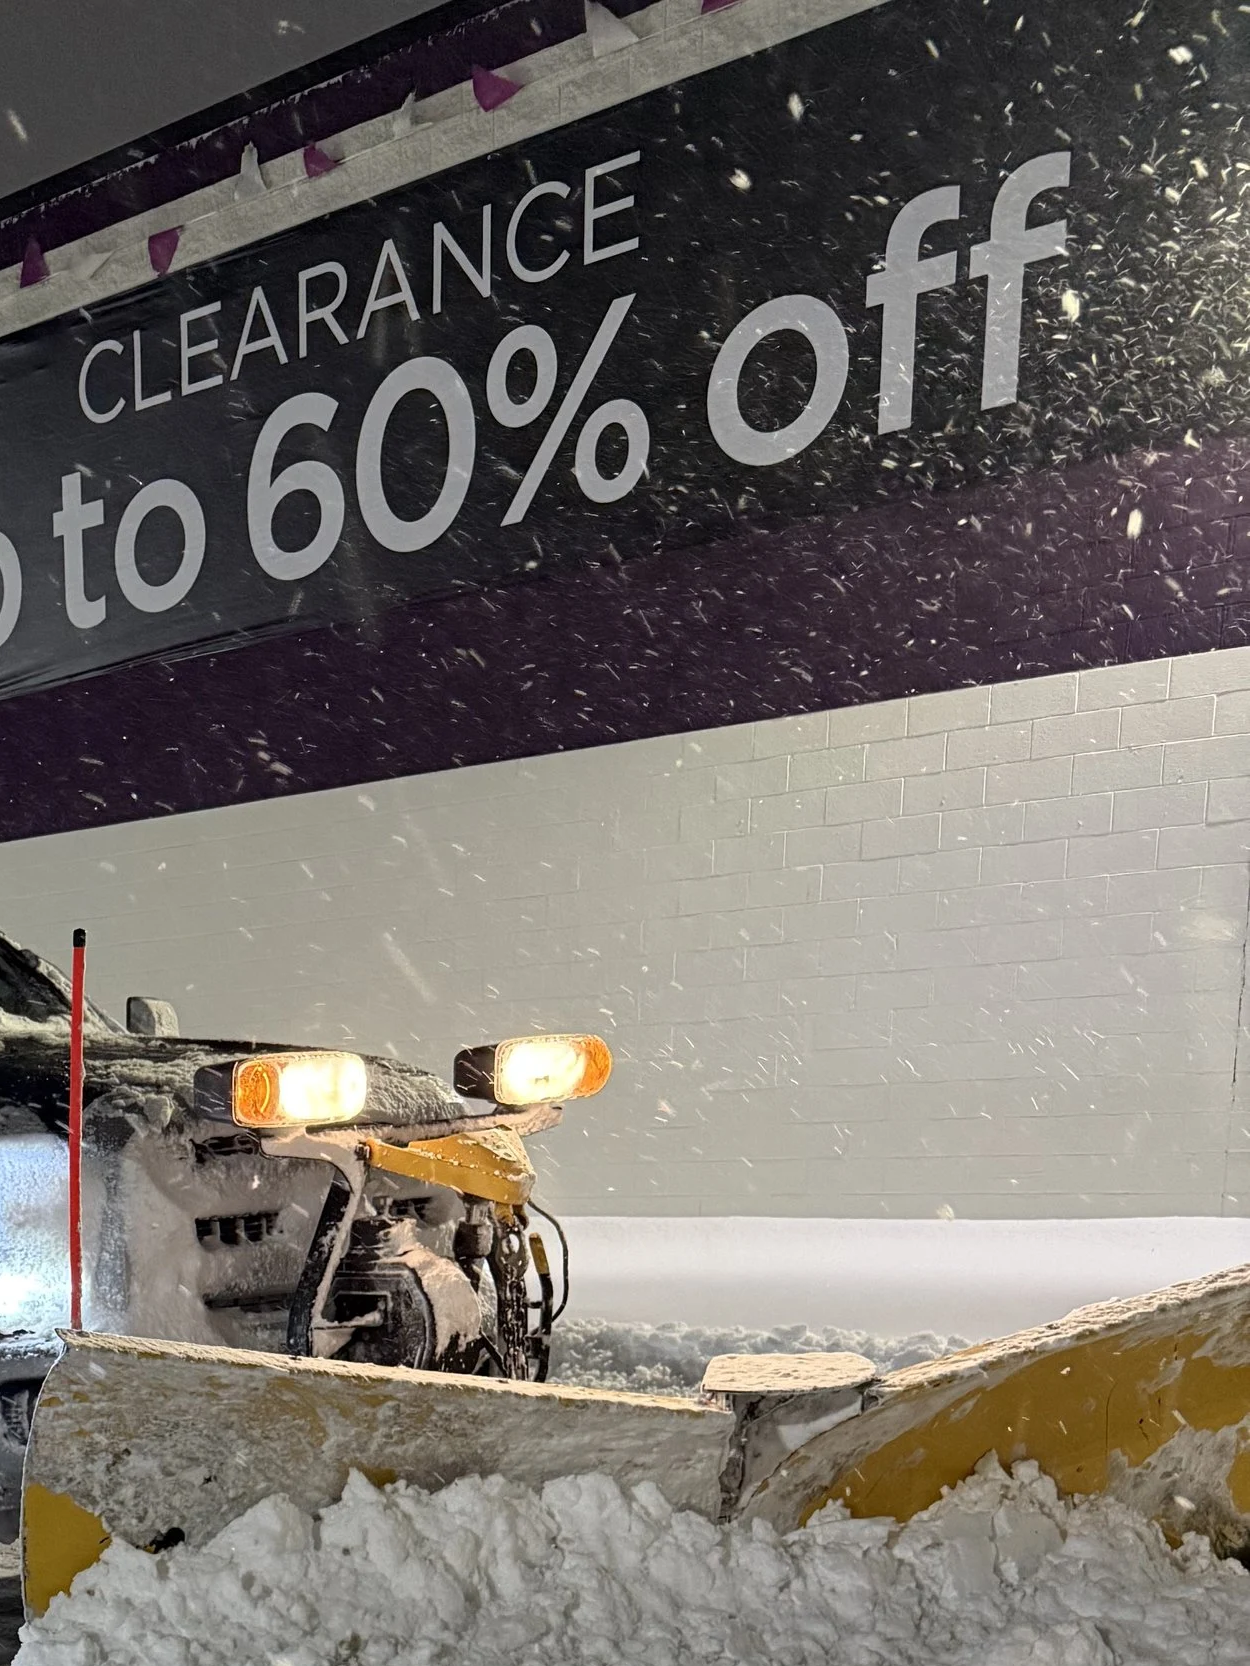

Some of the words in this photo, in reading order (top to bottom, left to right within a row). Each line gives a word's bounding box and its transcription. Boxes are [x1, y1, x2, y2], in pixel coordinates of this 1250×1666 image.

[52, 471, 206, 629] to
[247, 292, 652, 581] 60%
[707, 151, 1072, 467] off
[78, 151, 641, 423] CLEARANCE
